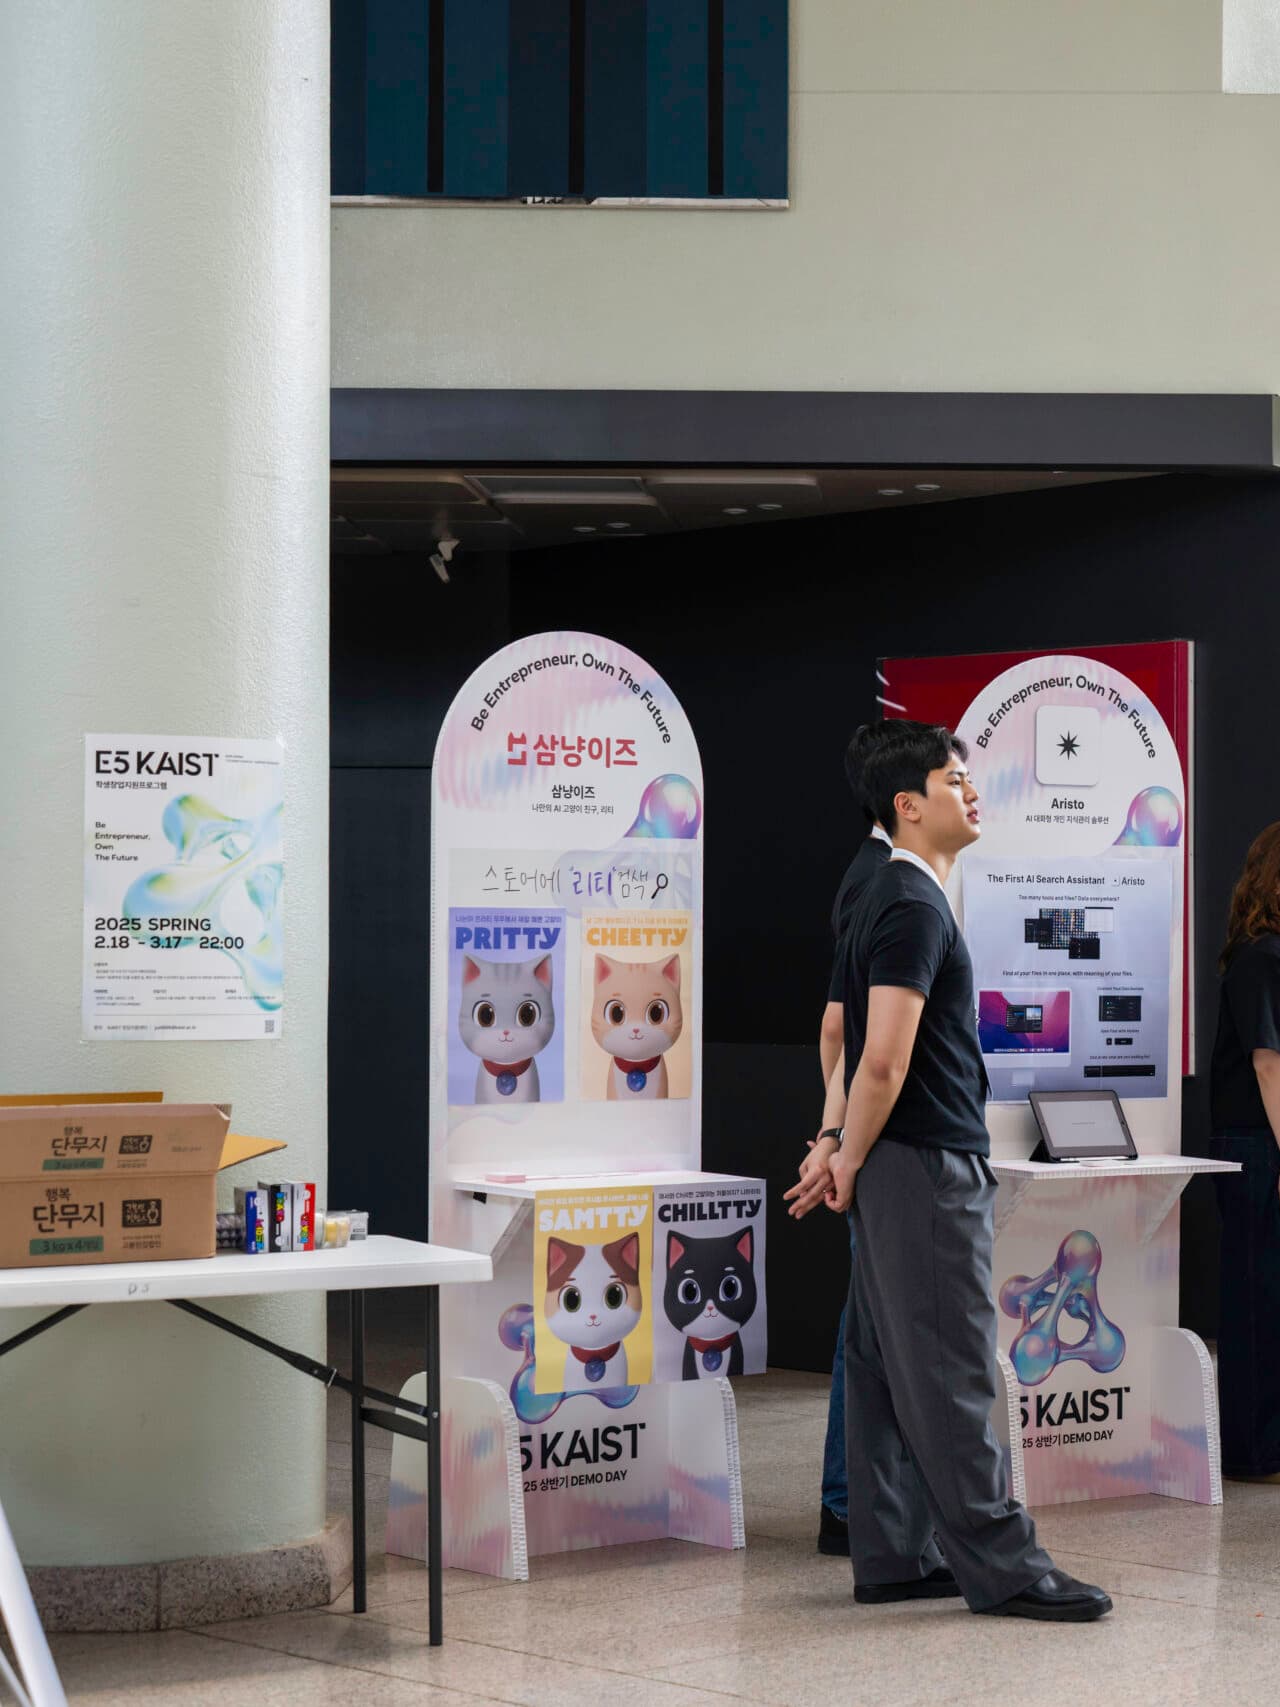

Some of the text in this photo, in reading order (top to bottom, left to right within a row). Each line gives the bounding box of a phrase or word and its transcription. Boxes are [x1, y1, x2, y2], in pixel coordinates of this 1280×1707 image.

[471, 653, 671, 743] Be Entrepreneur, Own The Future
[977, 675, 1156, 758] Be Entrepreneur, Own The Future
[533, 734, 638, 768] 삼냥이즈
[95, 750, 129, 774] E5
[137, 752, 219, 777] KAIST
[552, 785, 595, 799] 삼냥이즈
[563, 804, 582, 814] 고양이
[600, 806, 614, 815] 리티
[1051, 798, 1084, 810] Aristo
[95, 833, 151, 841] Entrepreneur,
[482, 865, 561, 894] 스토어에
[618, 868, 649, 900] 검색
[987, 874, 1105, 885] The First AI Search Assistant
[1121, 877, 1145, 886] Aristo
[95, 918, 211, 931] 2025 SPRING
[95, 936, 129, 949] 2.18
[151, 936, 181, 949] 3.17
[200, 937, 244, 949] 22:00
[455, 927, 561, 950] PRITTY
[586, 927, 688, 947] CHEETTY
[51, 1135, 108, 1157] 단무지
[45, 1188, 72, 1202] 행복
[33, 1202, 104, 1233] 단무지
[539, 1205, 648, 1232] SAMTTY
[658, 1199, 762, 1222] CHILLTTY
[1019, 1386, 1131, 1429] 5 KAIST
[519, 1422, 646, 1472] 5 KAIST
[1022, 1430, 1114, 1449] 25 상반기 DEMO DAY
[524, 1470, 627, 1492] 25 상반기 DEMO DAY
